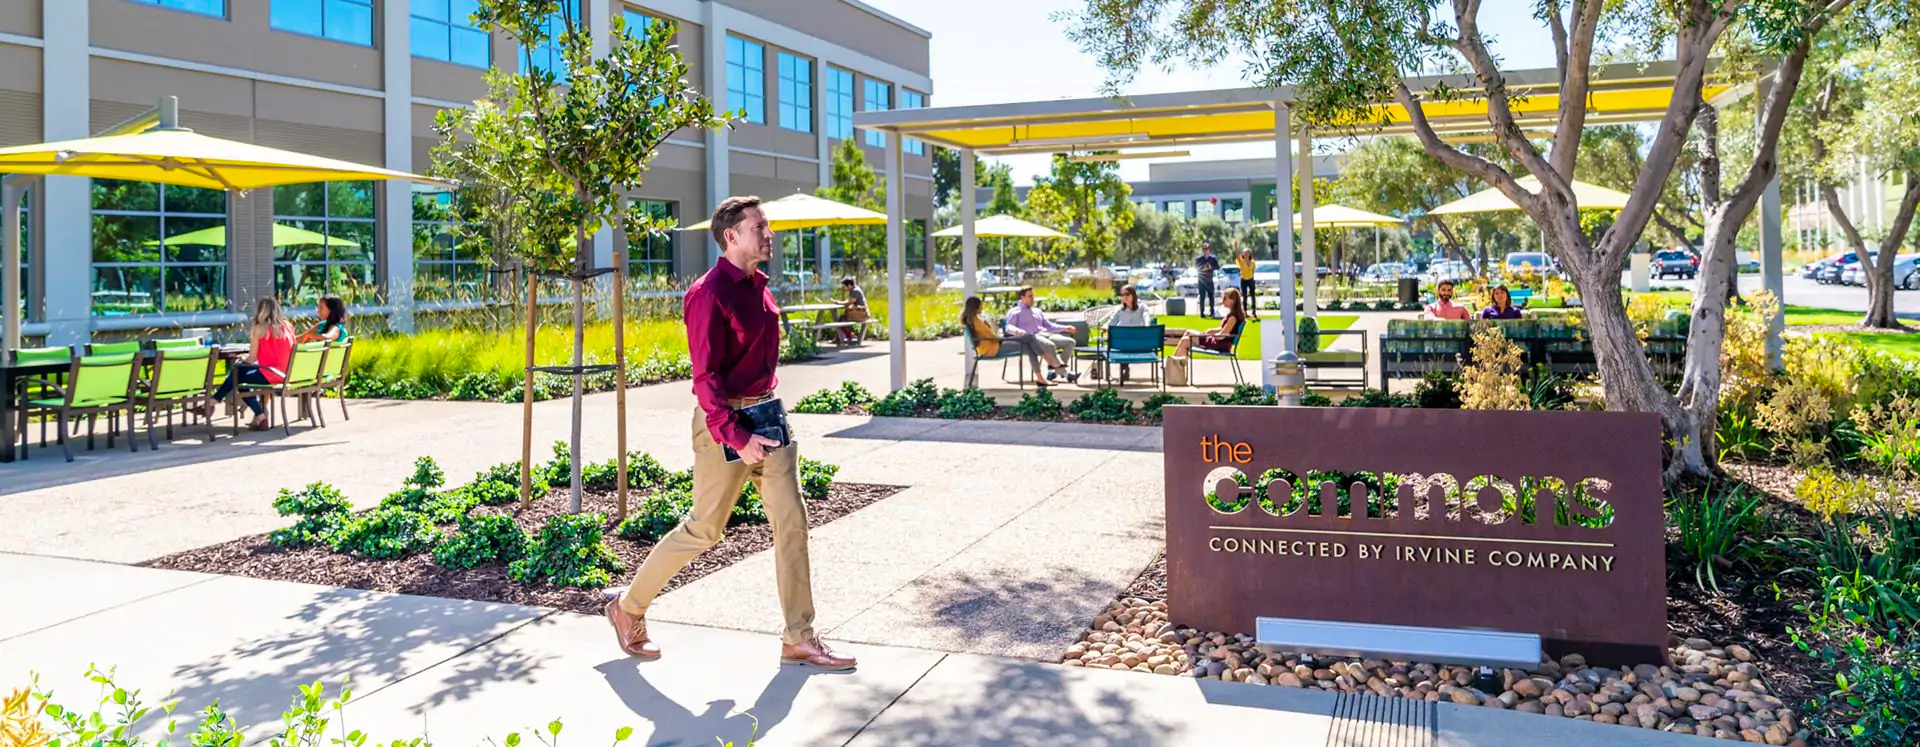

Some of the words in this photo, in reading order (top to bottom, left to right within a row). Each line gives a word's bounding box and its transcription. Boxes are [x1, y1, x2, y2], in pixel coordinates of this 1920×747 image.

[1200, 434, 1252, 463] the
[1203, 466, 1615, 529] commons
[1209, 537, 1347, 558] CONNECTED
[1358, 544, 1386, 560] BY
[1396, 546, 1476, 565] IRVINE
[1489, 551, 1616, 572] COMPANY
